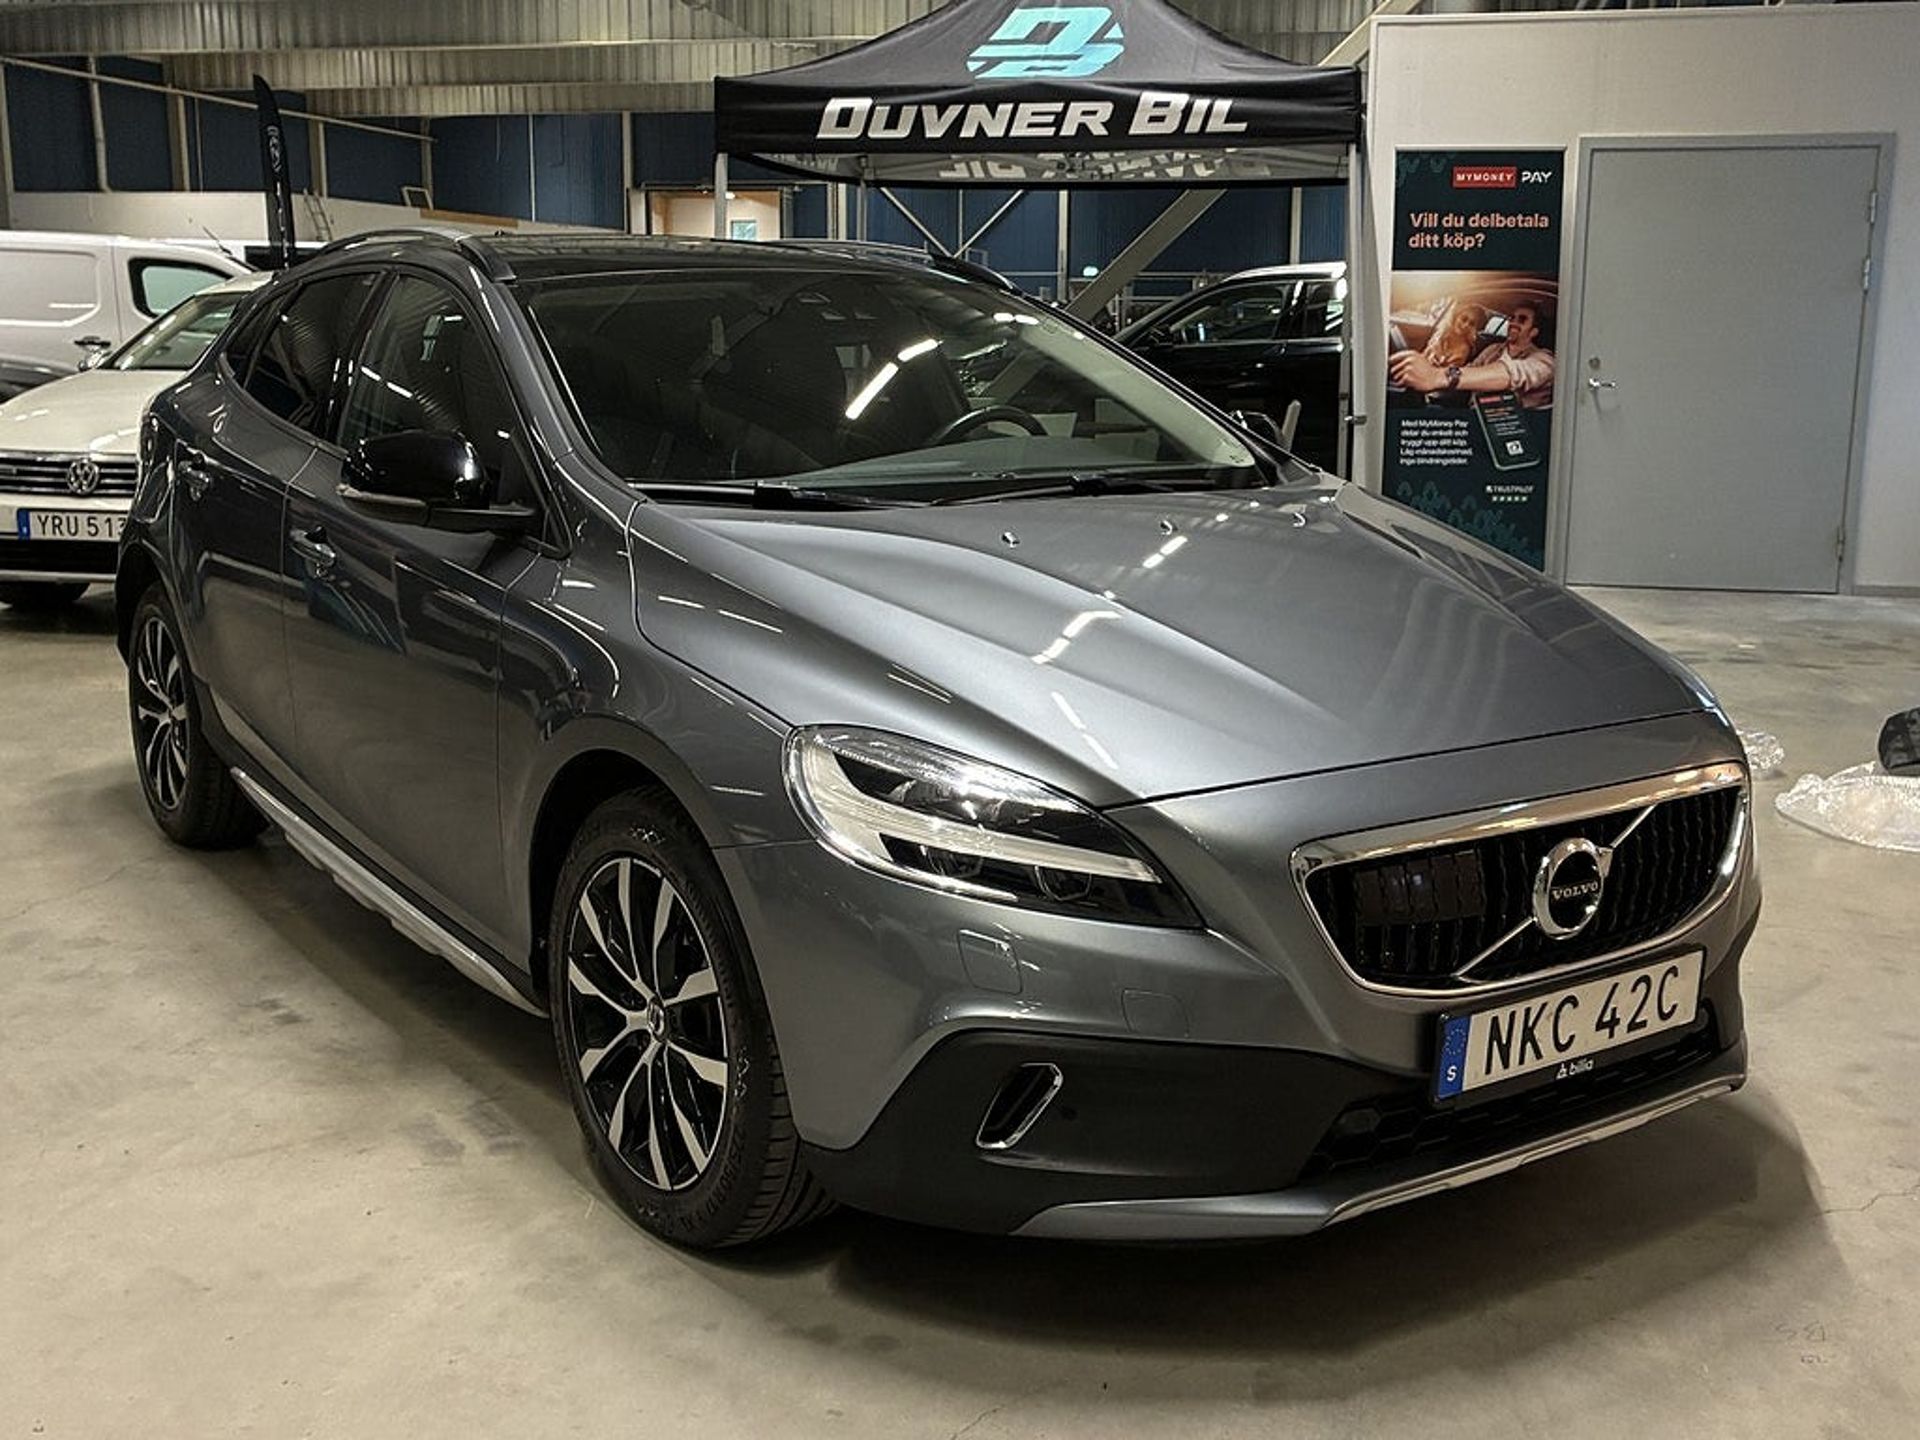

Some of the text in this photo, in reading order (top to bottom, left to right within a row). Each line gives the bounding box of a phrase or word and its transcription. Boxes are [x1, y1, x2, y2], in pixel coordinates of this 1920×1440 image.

[816, 91, 1249, 139] DUVNER BIL
[1456, 171, 1552, 183] MYMONEY PAY
[1410, 213, 1549, 228] Vill du delbetala
[1408, 233, 1486, 250] ditt köp?
[37, 515, 79, 537] YRU
[1552, 881, 1598, 899] VOLVO
[1485, 965, 1679, 1075] NKC 42C
[1446, 1066, 1457, 1081] S
